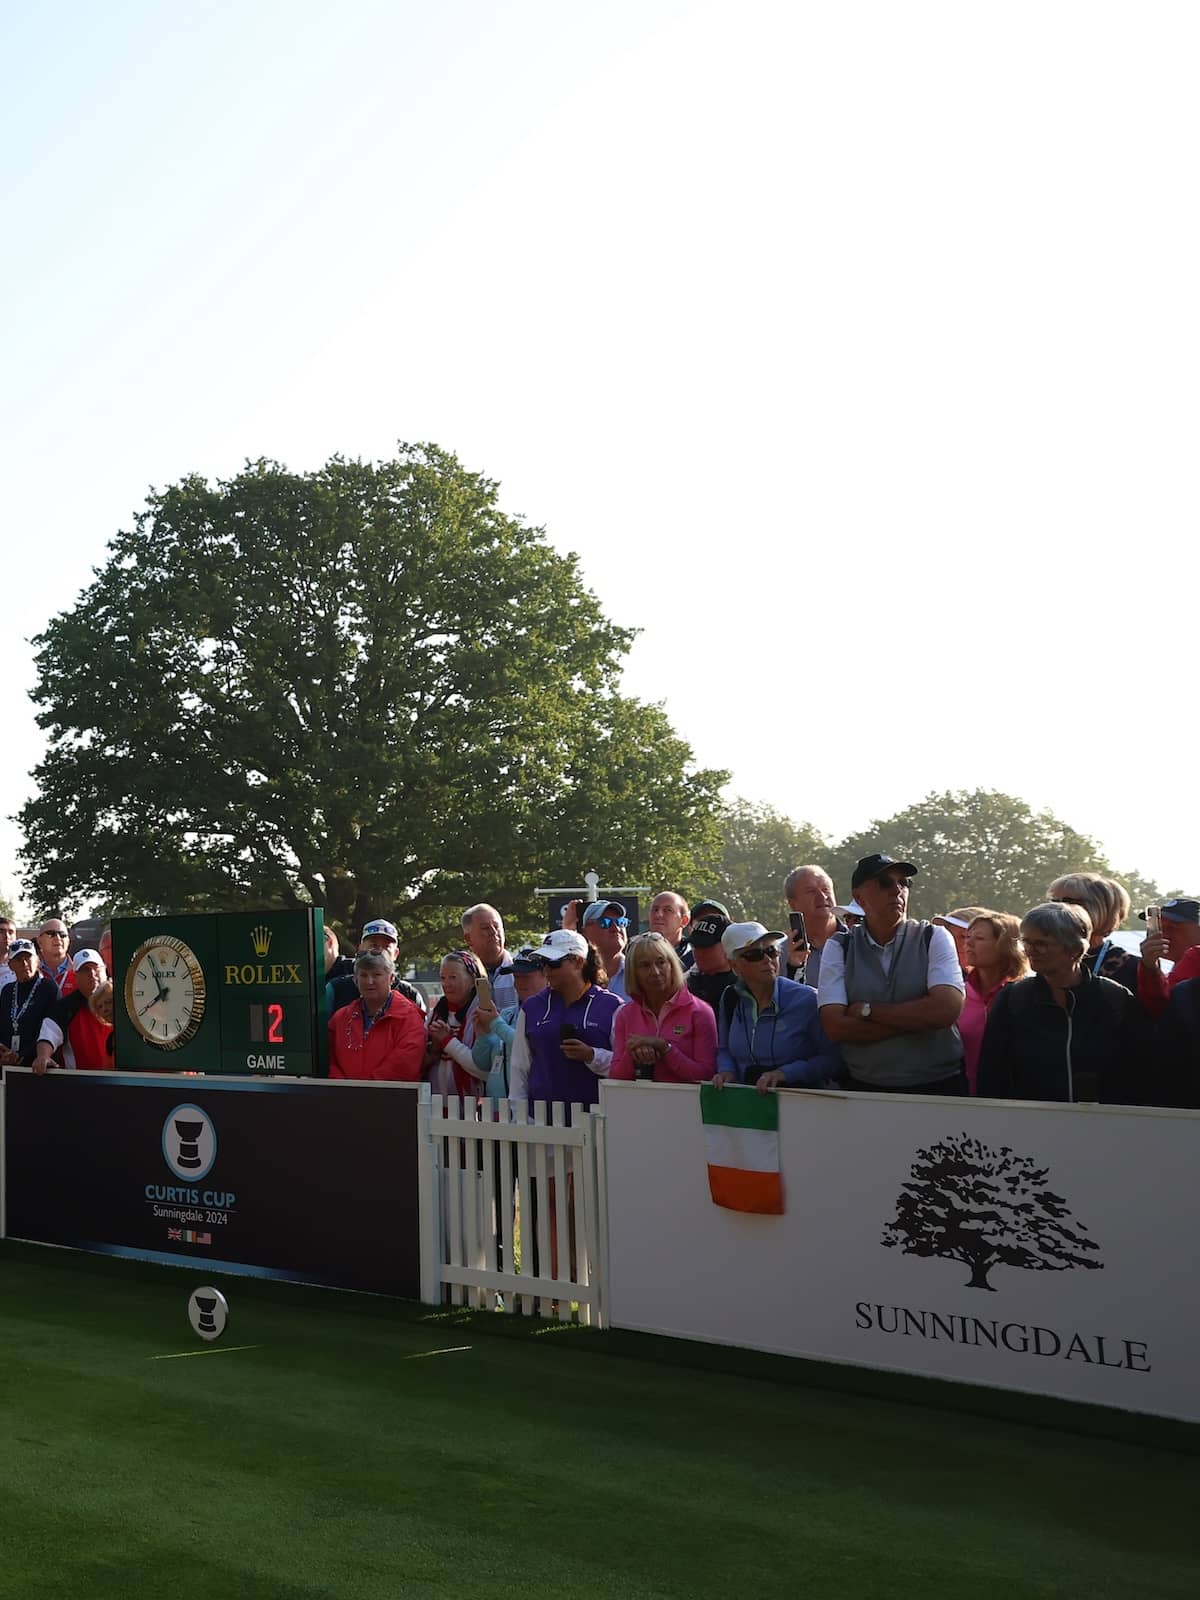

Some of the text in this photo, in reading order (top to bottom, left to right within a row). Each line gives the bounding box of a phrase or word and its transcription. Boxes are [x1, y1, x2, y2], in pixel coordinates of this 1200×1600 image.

[225, 964, 302, 985] ROLEX
[267, 1004, 285, 1043] 2
[247, 1055, 285, 1070] GAME
[145, 1185, 236, 1208] CURTIS CUP
[153, 1205, 228, 1225] Sunningdale 2024
[855, 1302, 1152, 1372] SUNNINGDALE
